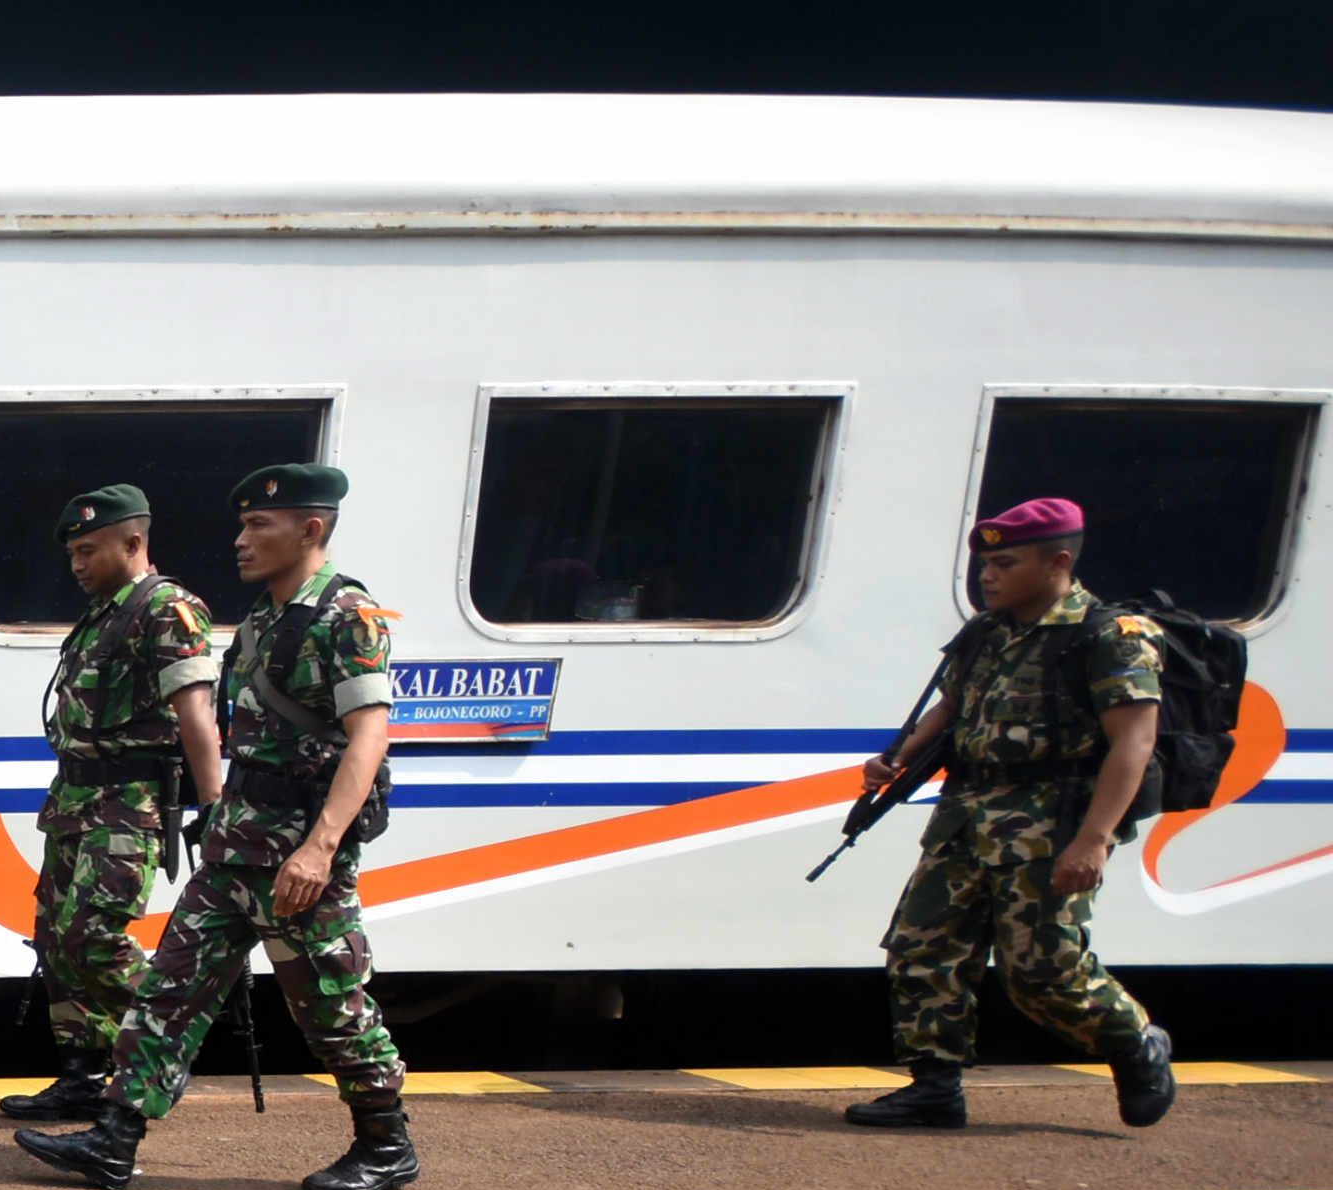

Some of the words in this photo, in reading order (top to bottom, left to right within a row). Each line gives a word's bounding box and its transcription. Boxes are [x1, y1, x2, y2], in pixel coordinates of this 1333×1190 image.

[390, 668, 443, 697] KAL
[449, 668, 543, 697] BABAT
[414, 705, 512, 720] BOJONEGORO
[529, 705, 547, 718] PP
